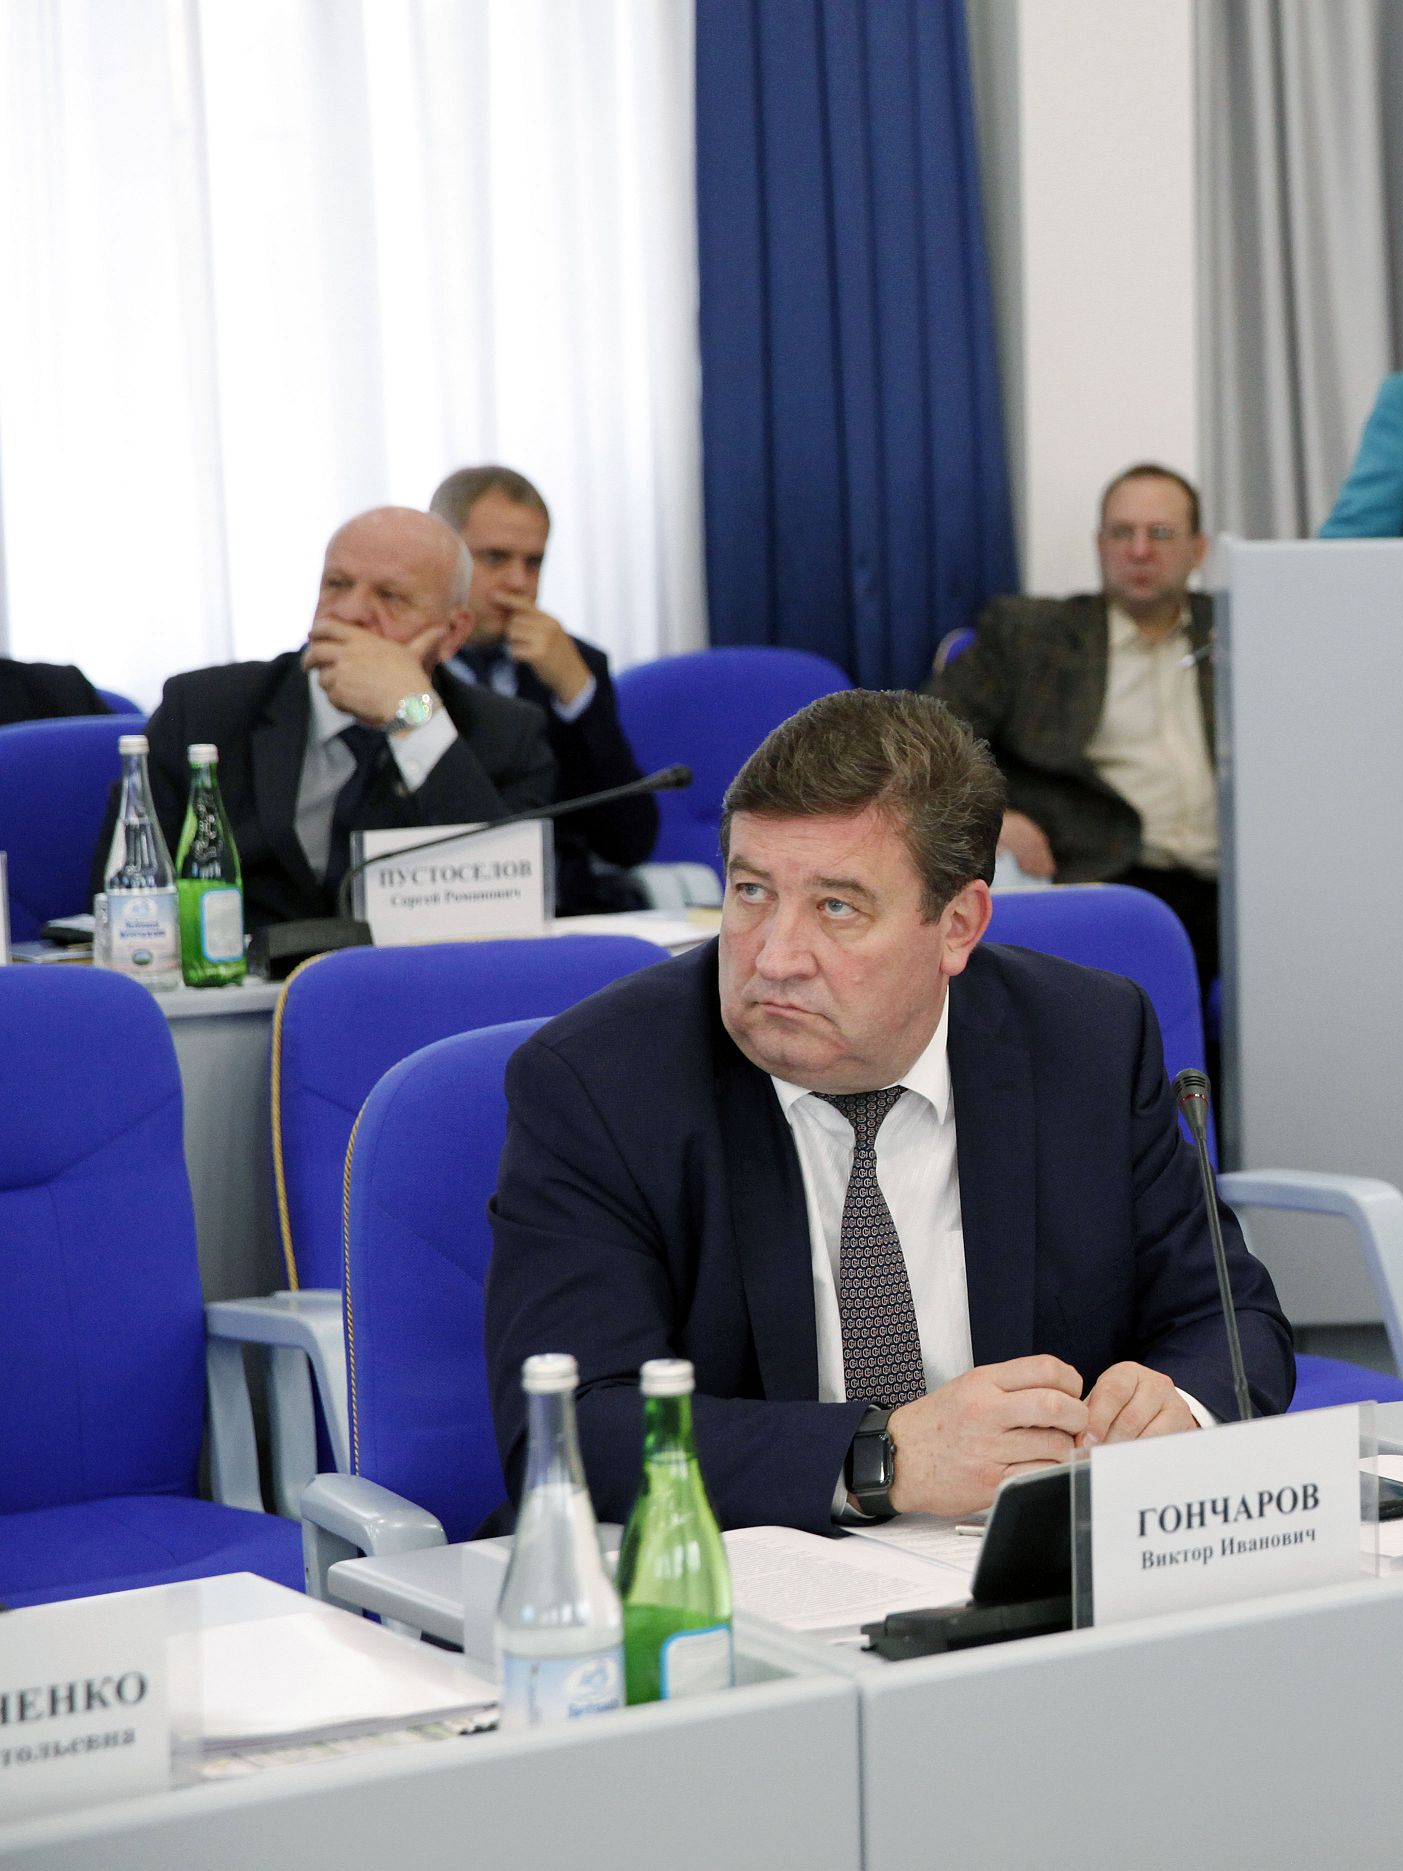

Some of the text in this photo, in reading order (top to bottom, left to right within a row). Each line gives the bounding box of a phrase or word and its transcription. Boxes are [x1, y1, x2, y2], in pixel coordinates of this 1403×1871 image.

[379, 860, 532, 887] ПУСТОСЕЛОВ
[1137, 1483, 1320, 1537] ГОНЧАРОВ
[1141, 1528, 1316, 1569] Виктор Иванович
